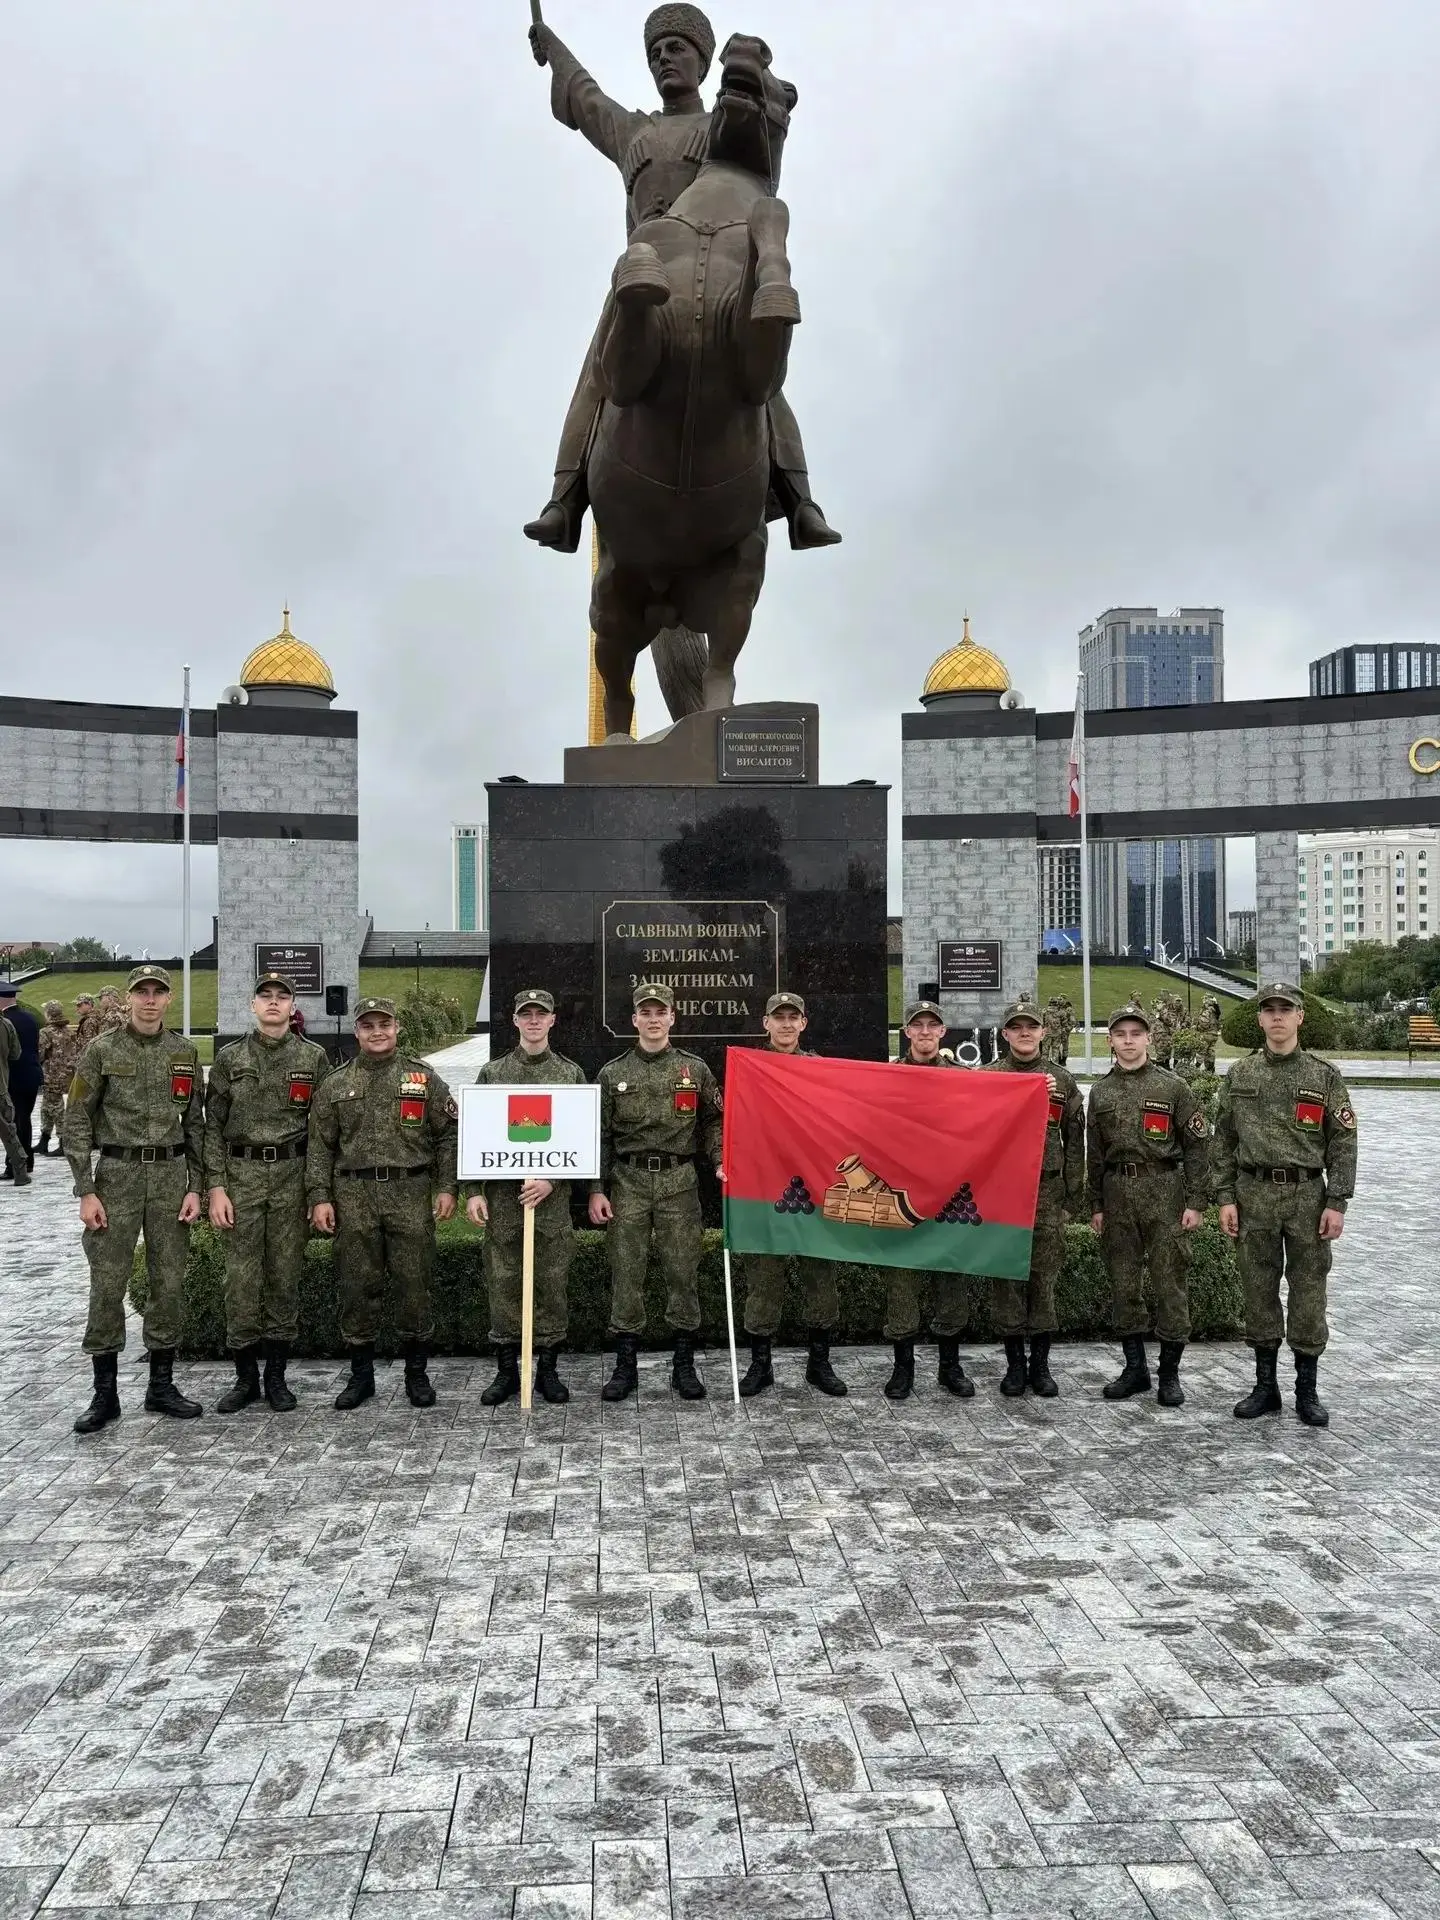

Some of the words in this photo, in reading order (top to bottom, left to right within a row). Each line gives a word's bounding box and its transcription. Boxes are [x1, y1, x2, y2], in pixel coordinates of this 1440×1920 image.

[725, 732, 744, 740] ГЕРОЙ
[744, 732, 781, 740] СОВЕТСКОГО
[782, 732, 803, 740] СОЮЗА
[736, 757, 793, 767] ВИСАИТОВ
[615, 923, 693, 938] СЛАВНЫМ
[697, 923, 766, 938] ВОИНАМ-
[642, 949, 740, 962] ЗЕМЛЯКАМ-
[676, 1000, 750, 1016] ЧЕСТВА
[480, 1150, 578, 1168] БРЯНСК
